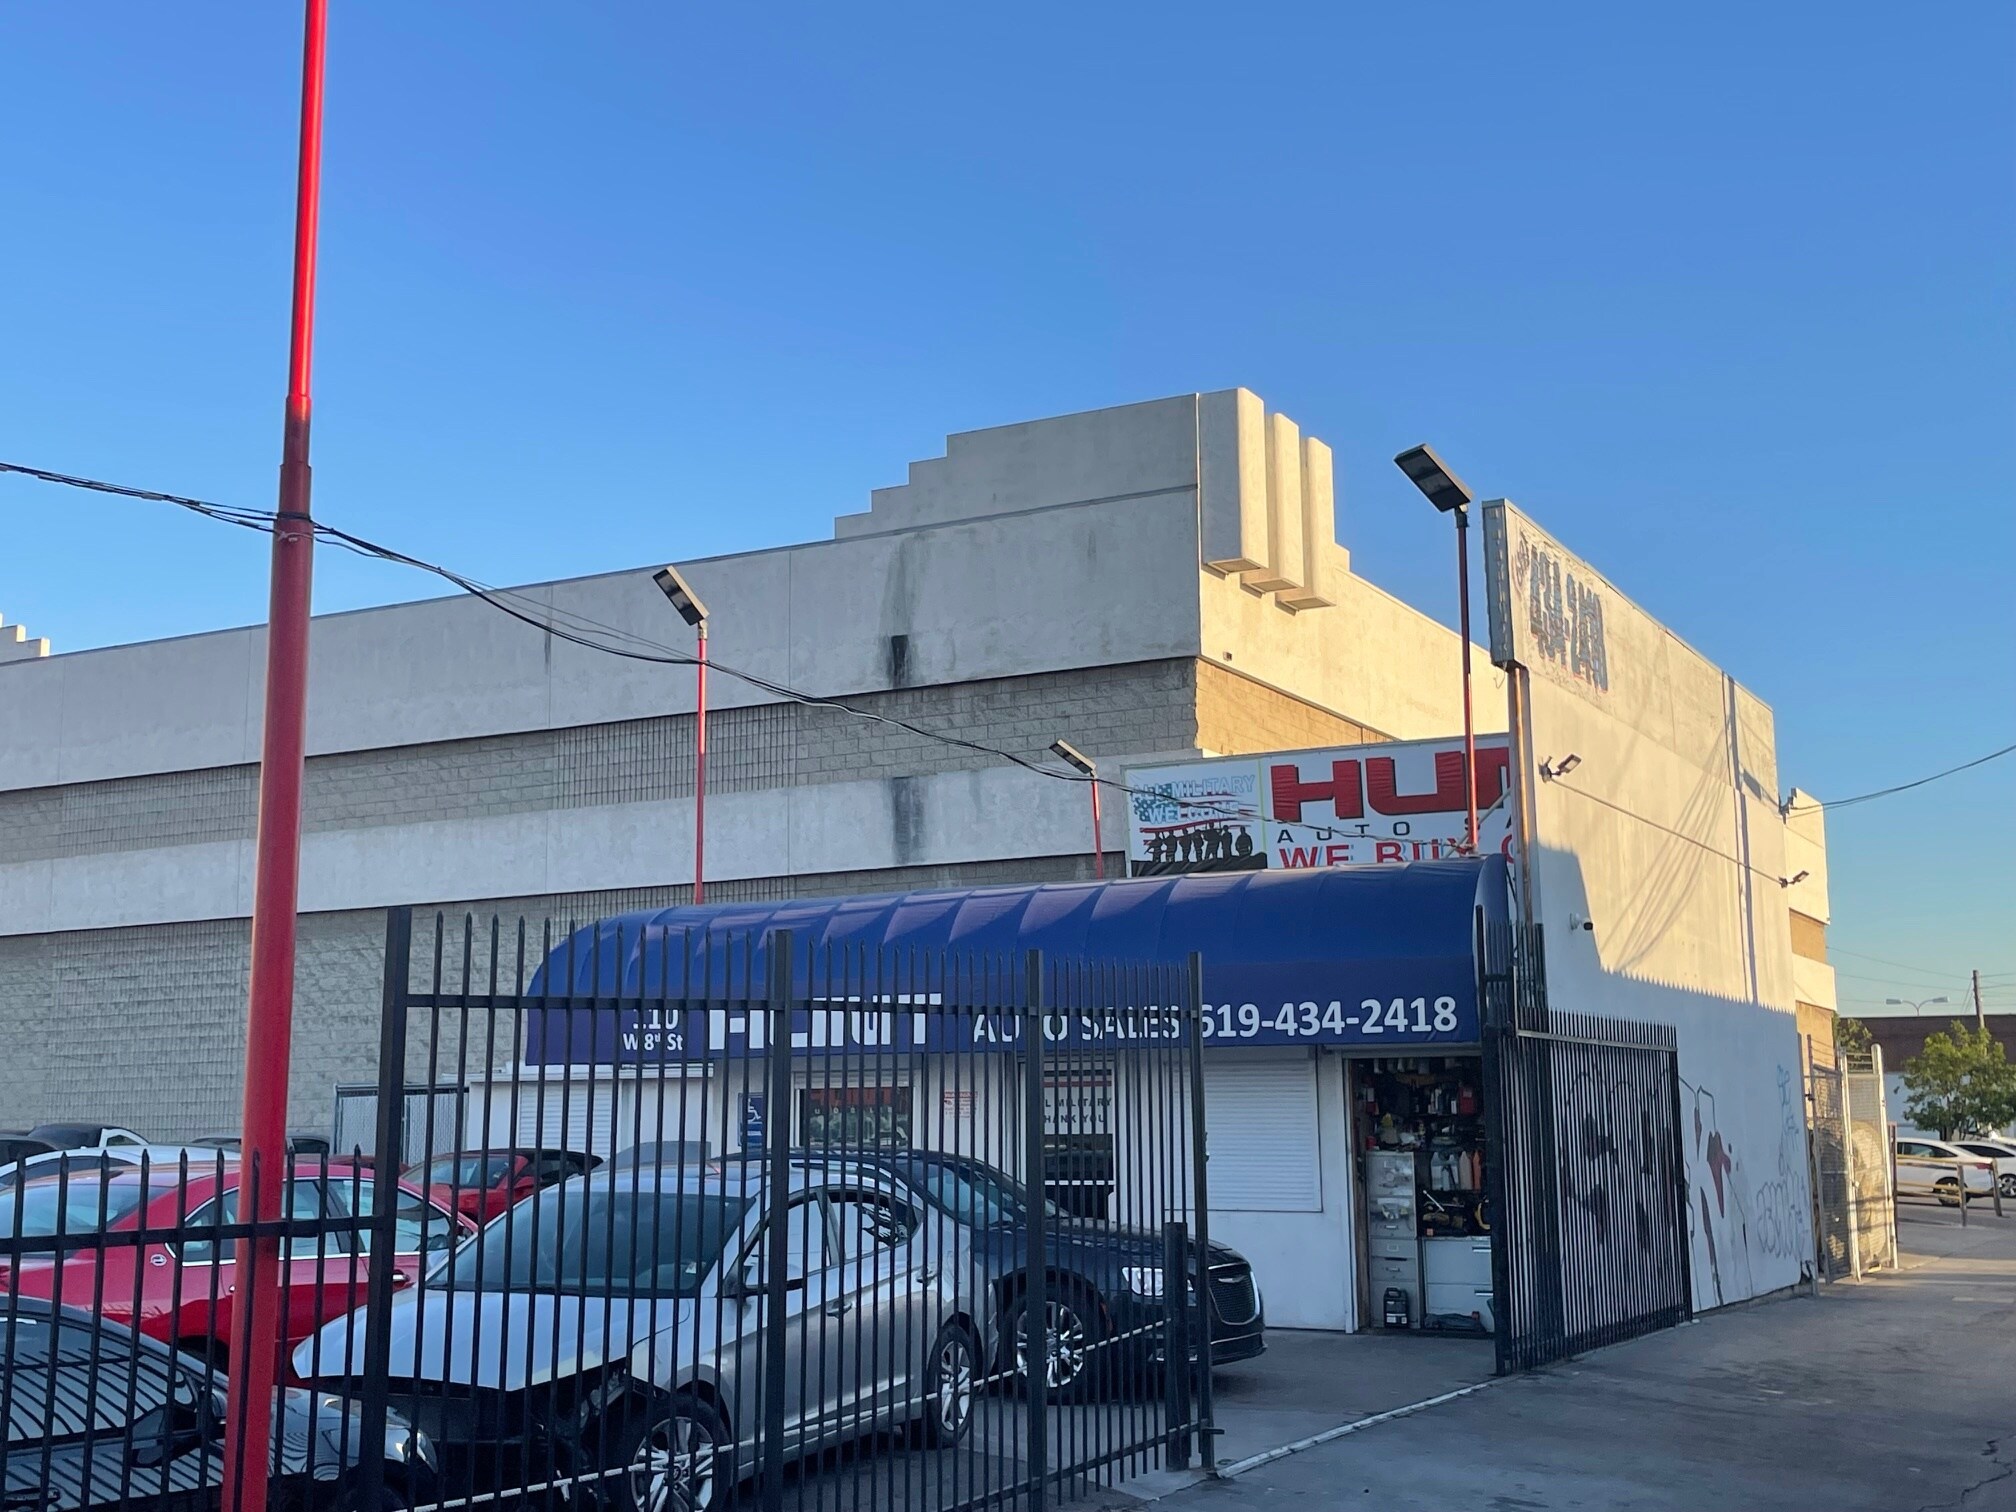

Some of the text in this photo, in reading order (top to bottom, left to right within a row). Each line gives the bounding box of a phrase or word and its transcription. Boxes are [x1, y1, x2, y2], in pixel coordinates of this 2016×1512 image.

[1170, 774, 1256, 798] MILITARY
[1148, 801, 1240, 825] WELCOME
[1277, 821, 1411, 844] AUTO
[973, 1014, 1068, 1042] AUO
[1082, 1005, 1181, 1040] SALES
[1201, 996, 1458, 1038] 619-434-2418
[623, 1033, 639, 1050] W
[667, 1033, 684, 1050] St
